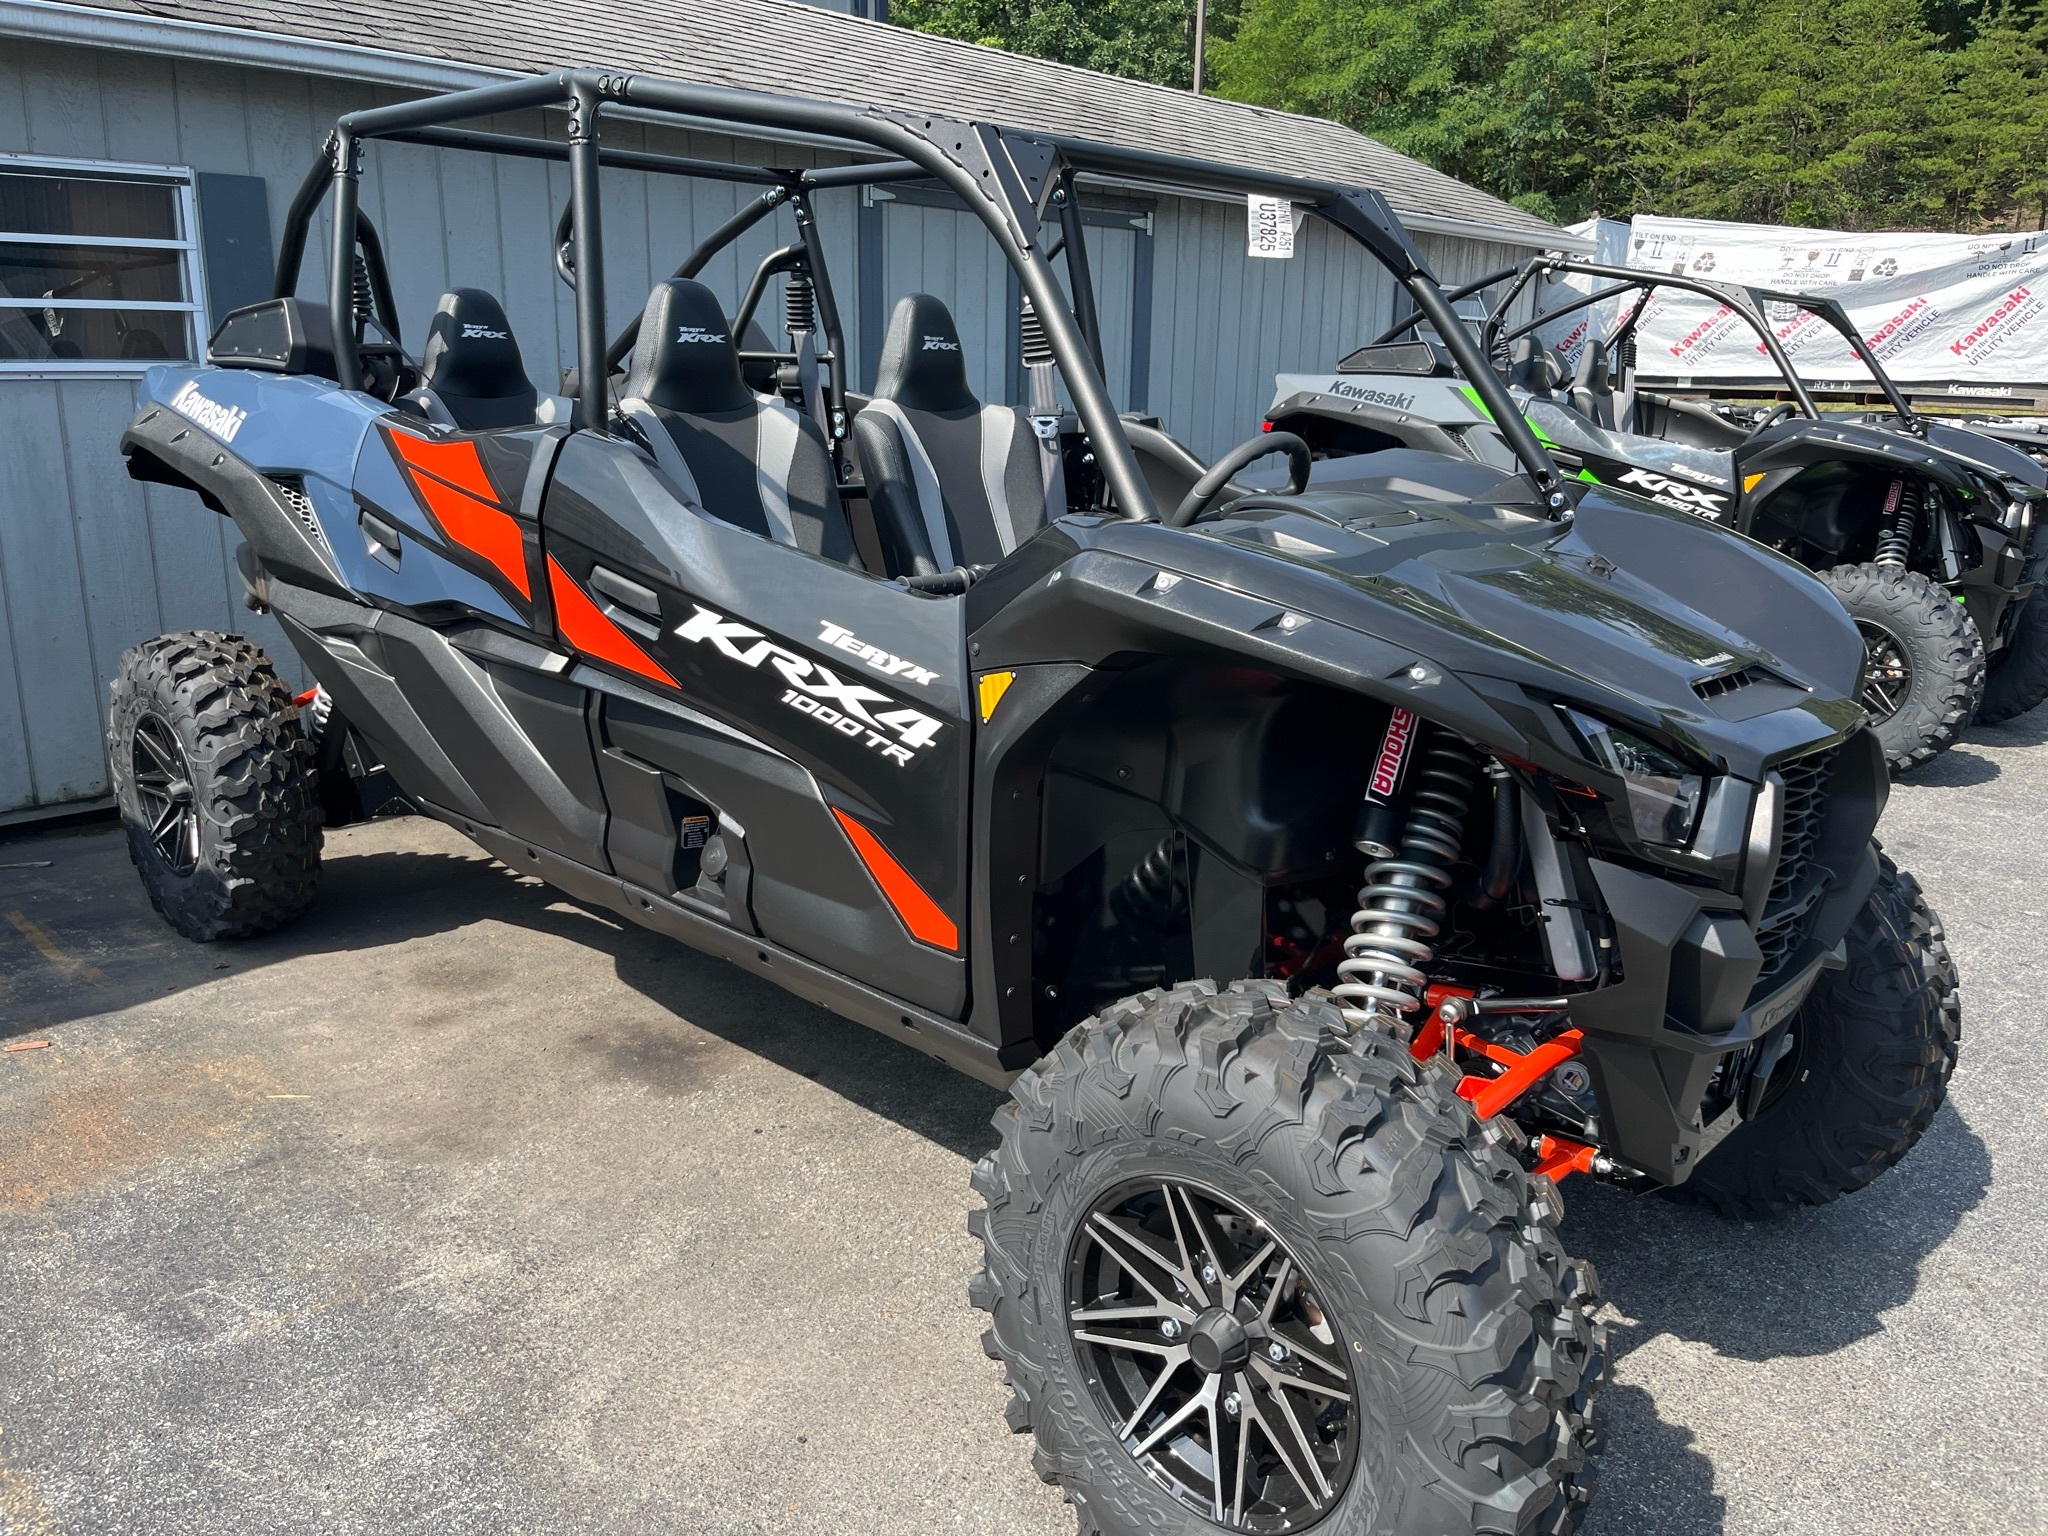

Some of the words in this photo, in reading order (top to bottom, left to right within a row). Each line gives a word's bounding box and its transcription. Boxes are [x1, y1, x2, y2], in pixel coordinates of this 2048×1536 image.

[1259, 203, 1278, 252] U37825
[1278, 231, 1292, 251] A251
[1966, 271, 1997, 279] HANDLE
[1636, 306, 1666, 331] EHICLE
[1669, 303, 1733, 358] Kawasa
[1804, 320, 1829, 339] VEHI
[1949, 285, 2031, 356] Kawasaki
[1968, 335, 2004, 366] UTILITY
[2003, 301, 2046, 337] VEHICLE
[461, 329, 508, 340] KRX
[677, 332, 727, 343] KRX
[922, 341, 959, 351] KRX
[1686, 339, 1717, 367] UTILITY
[1713, 317, 1745, 341] VEHIC
[1877, 341, 1904, 365] TILITY
[1901, 309, 1942, 343] VEHICLE
[1328, 380, 1416, 411] Kawasaki
[1813, 380, 1836, 390] REV
[1947, 384, 2013, 397] Kawasaki
[171, 380, 248, 443] Kawasaki
[1617, 467, 1729, 512] KRX
[1885, 481, 1901, 512] SHOWA
[673, 603, 944, 749] KRX4
[1370, 706, 1413, 797] SHOWA
